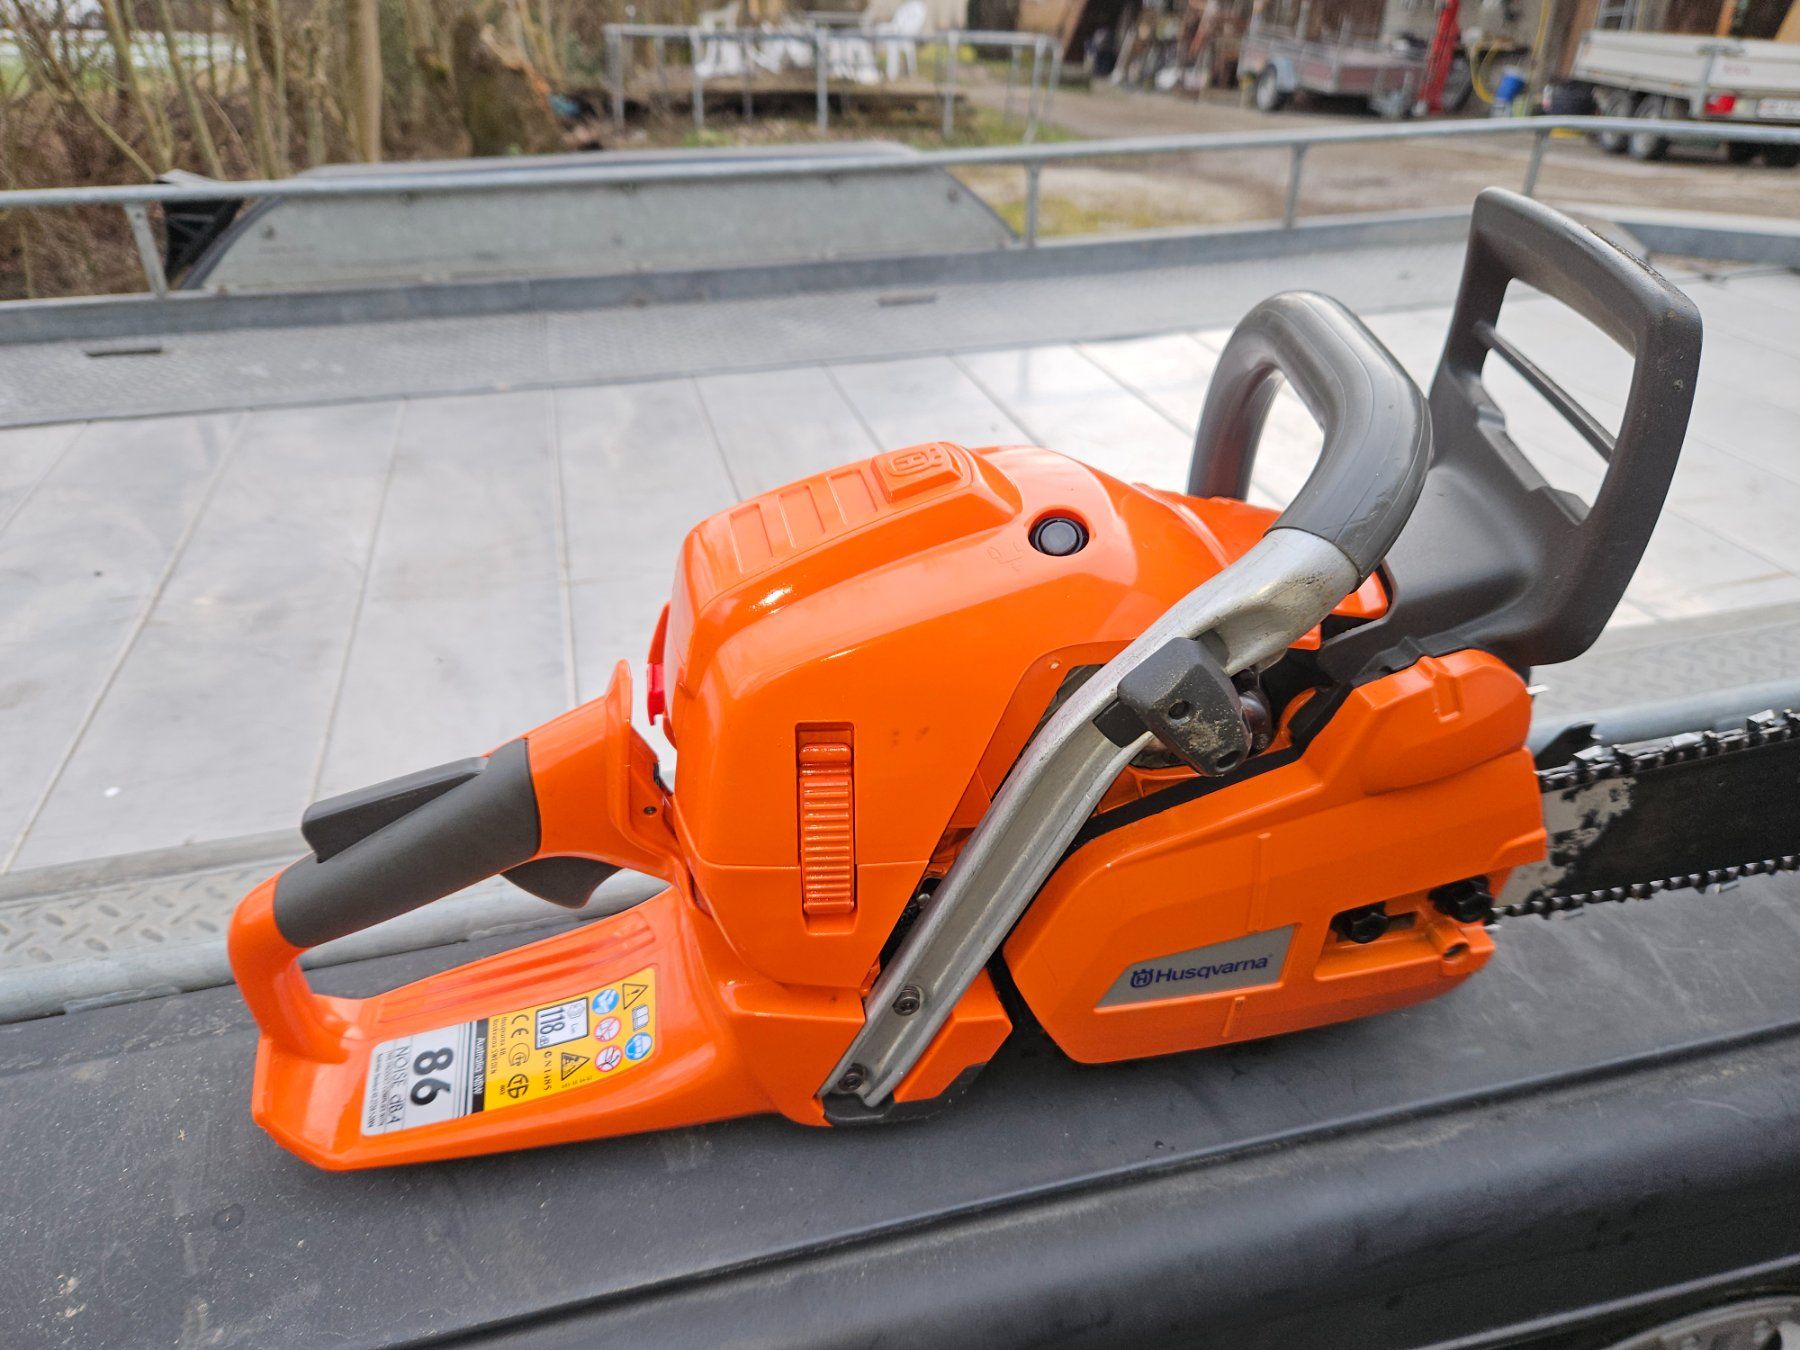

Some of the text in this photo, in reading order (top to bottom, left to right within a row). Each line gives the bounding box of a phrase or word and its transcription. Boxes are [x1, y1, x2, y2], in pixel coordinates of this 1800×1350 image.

[1154, 956, 1269, 984] Husqvarna
[510, 1014, 530, 1039] CE
[540, 1008, 565, 1035] 118
[391, 1046, 411, 1088] NOISE
[475, 1037, 486, 1073] Australia
[410, 1047, 454, 1106] 86
